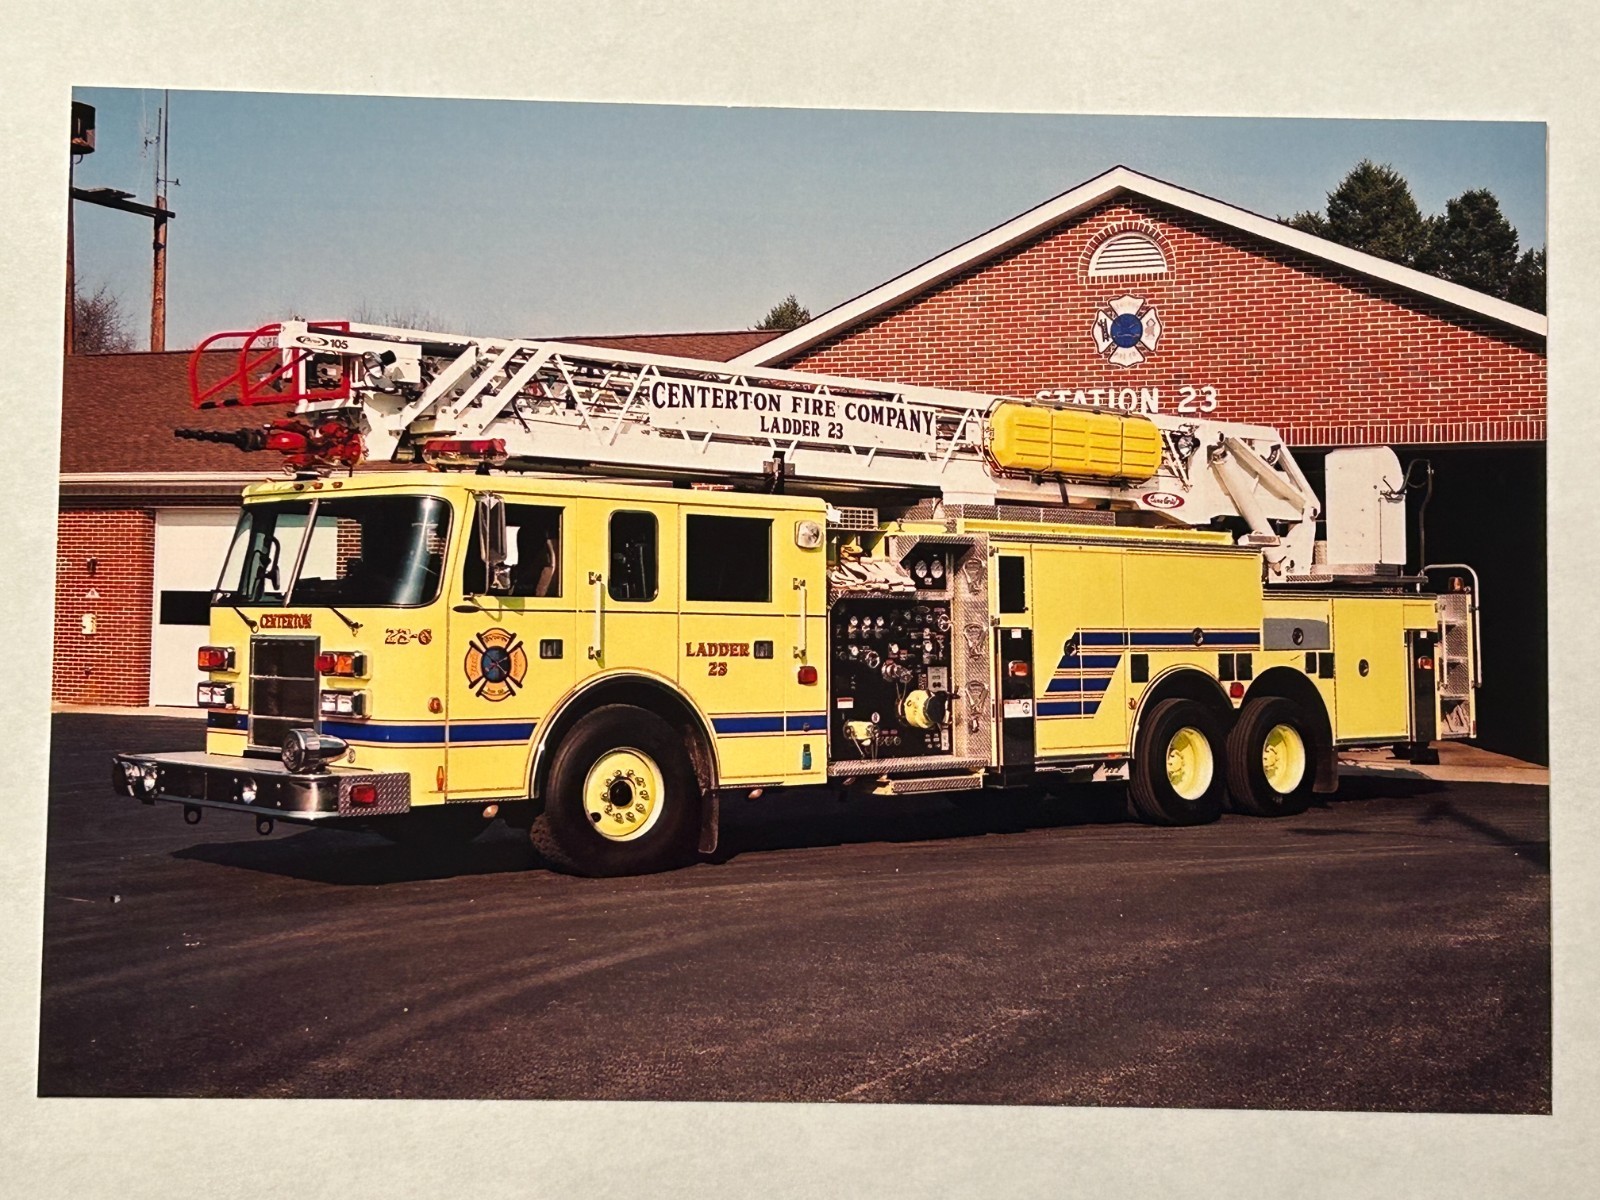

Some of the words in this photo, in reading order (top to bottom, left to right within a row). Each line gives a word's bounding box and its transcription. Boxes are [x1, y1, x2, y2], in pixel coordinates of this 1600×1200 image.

[330, 339, 349, 349] 105
[652, 381, 781, 412] CENTERTON
[791, 396, 836, 418] FIRE
[845, 402, 934, 436] COMPANY
[1177, 385, 1218, 413] 23
[760, 416, 820, 437] LADDER
[828, 422, 844, 440] 23
[686, 642, 750, 657] LADDER
[708, 661, 728, 676] 23
